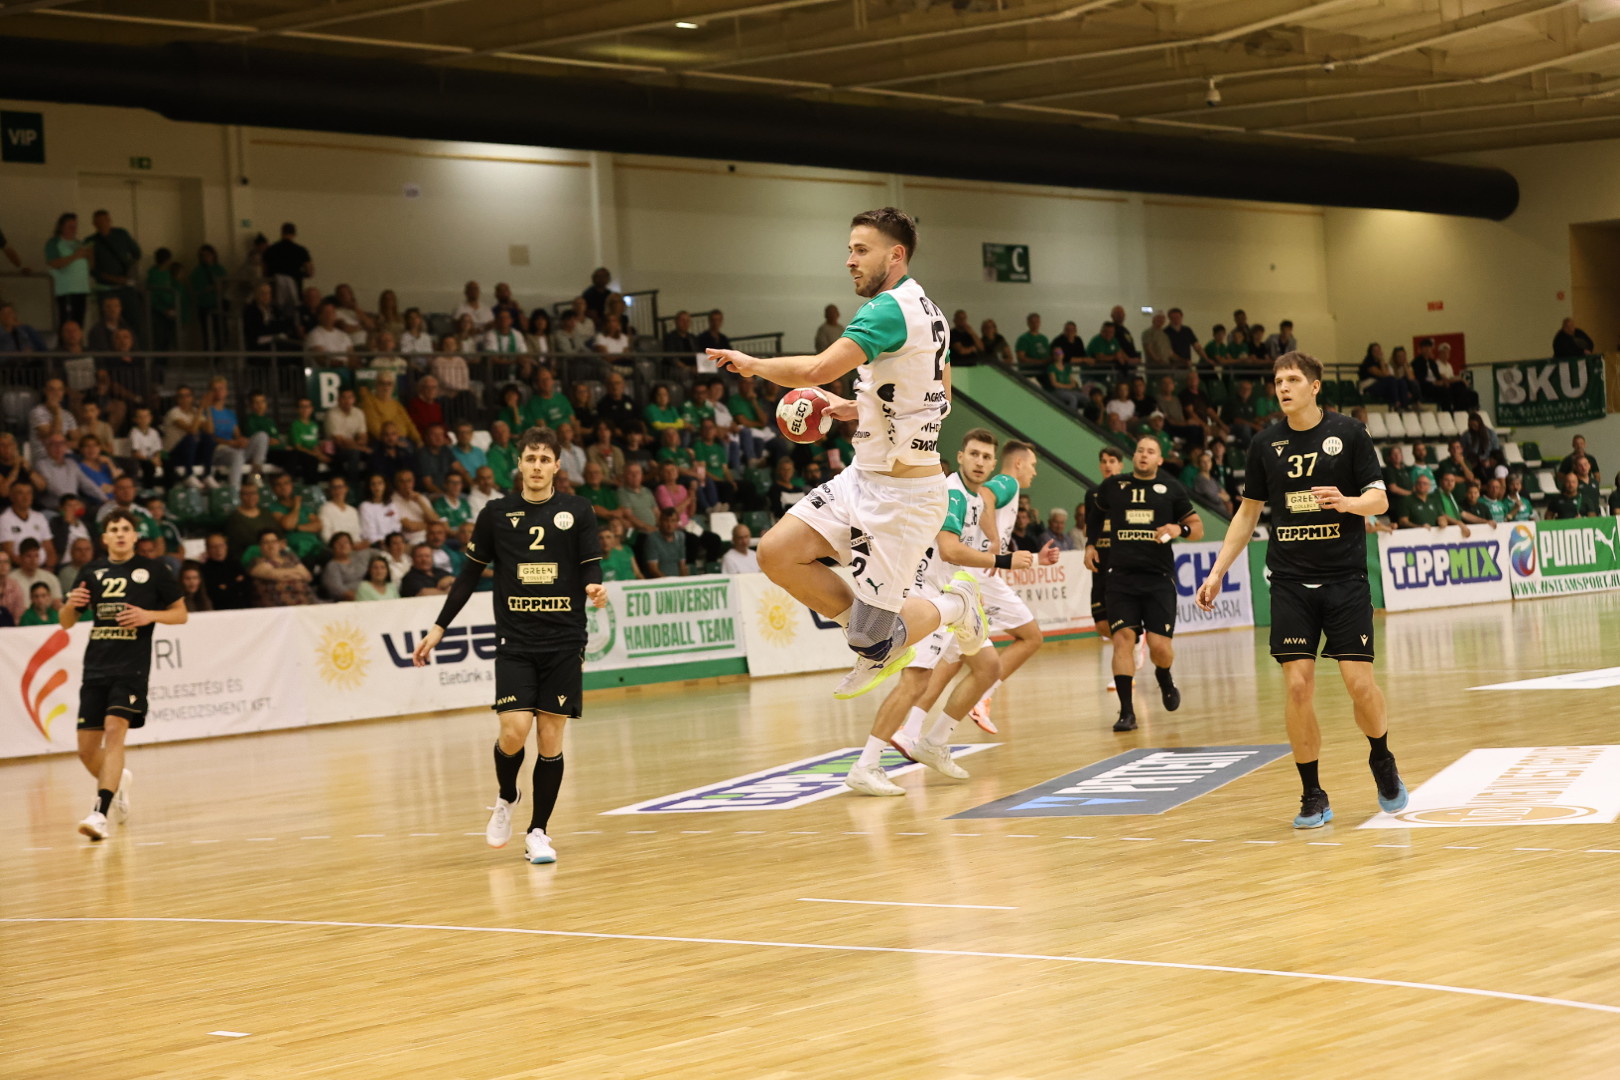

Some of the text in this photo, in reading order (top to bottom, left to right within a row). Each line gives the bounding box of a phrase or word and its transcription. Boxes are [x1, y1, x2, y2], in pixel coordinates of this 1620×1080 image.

[8, 129, 37, 146] VIP
[1012, 247, 1025, 273] C
[319, 372, 341, 409] B
[1497, 359, 1589, 405] BKU
[791, 401, 809, 433] SELECT
[1287, 452, 1318, 478] 37
[1131, 489, 1146, 503] 11
[529, 526, 545, 550] 2
[1118, 530, 1157, 541] TiPPMI
[1540, 528, 1597, 568] PUMA
[102, 578, 127, 598] 22
[1016, 586, 1067, 600] ERVICE
[626, 586, 728, 617] ETO UNIVERSITY
[623, 621, 695, 650] HANDBALL
[697, 617, 735, 644] TEAM
[1283, 637, 1307, 645] MVM
[155, 637, 183, 670] RI
[149, 681, 223, 700] EJLESZTÉSI
[150, 700, 246, 721] MENEDZSMENT
[1052, 750, 1260, 795] PATENT
